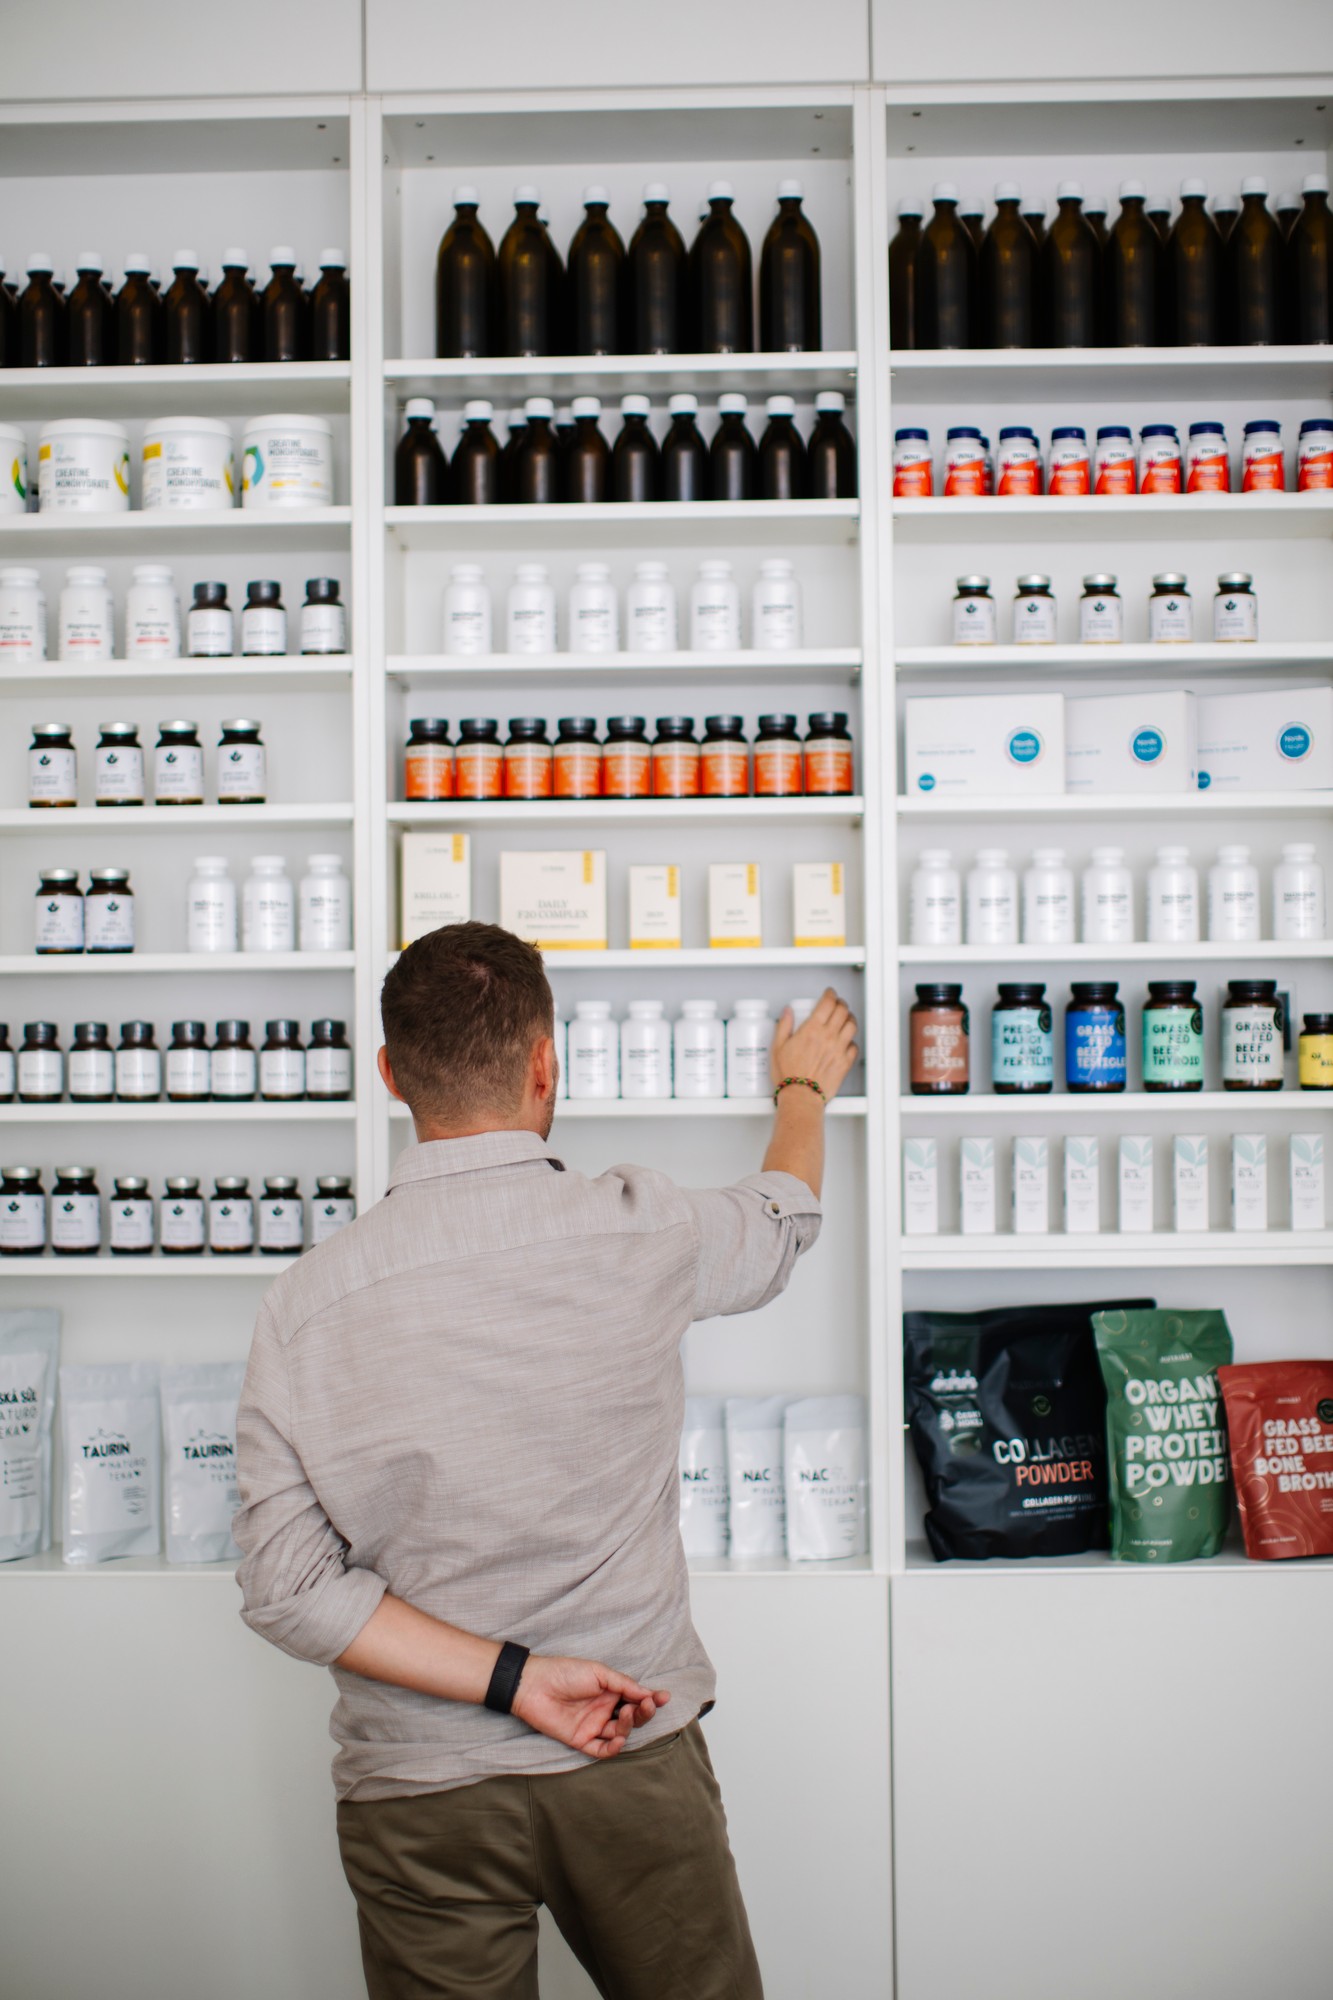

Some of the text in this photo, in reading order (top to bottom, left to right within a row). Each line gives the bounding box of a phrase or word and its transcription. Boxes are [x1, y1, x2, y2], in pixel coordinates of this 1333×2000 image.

[538, 900, 568, 909] DAILY
[537, 909, 588, 920] COMPLEX
[1235, 1022, 1273, 1032] GRASS
[1235, 1043, 1263, 1053] BEEF
[1235, 1053, 1271, 1063] LIVER
[1125, 1373, 1220, 1406] ORGAN
[1144, 1401, 1218, 1432] WHEY
[1262, 1417, 1321, 1438] GRASS
[81, 1441, 131, 1458] TAURIN
[183, 1443, 234, 1460] TAURIN
[1126, 1430, 1226, 1461] PROTEI
[1264, 1437, 1299, 1457] FED
[1015, 1460, 1095, 1487] POWDER
[1126, 1458, 1228, 1489] POWDE
[1254, 1455, 1306, 1476] BONE
[682, 1468, 710, 1482] NAC
[743, 1468, 770, 1482] NAC
[800, 1468, 829, 1482] NAC
